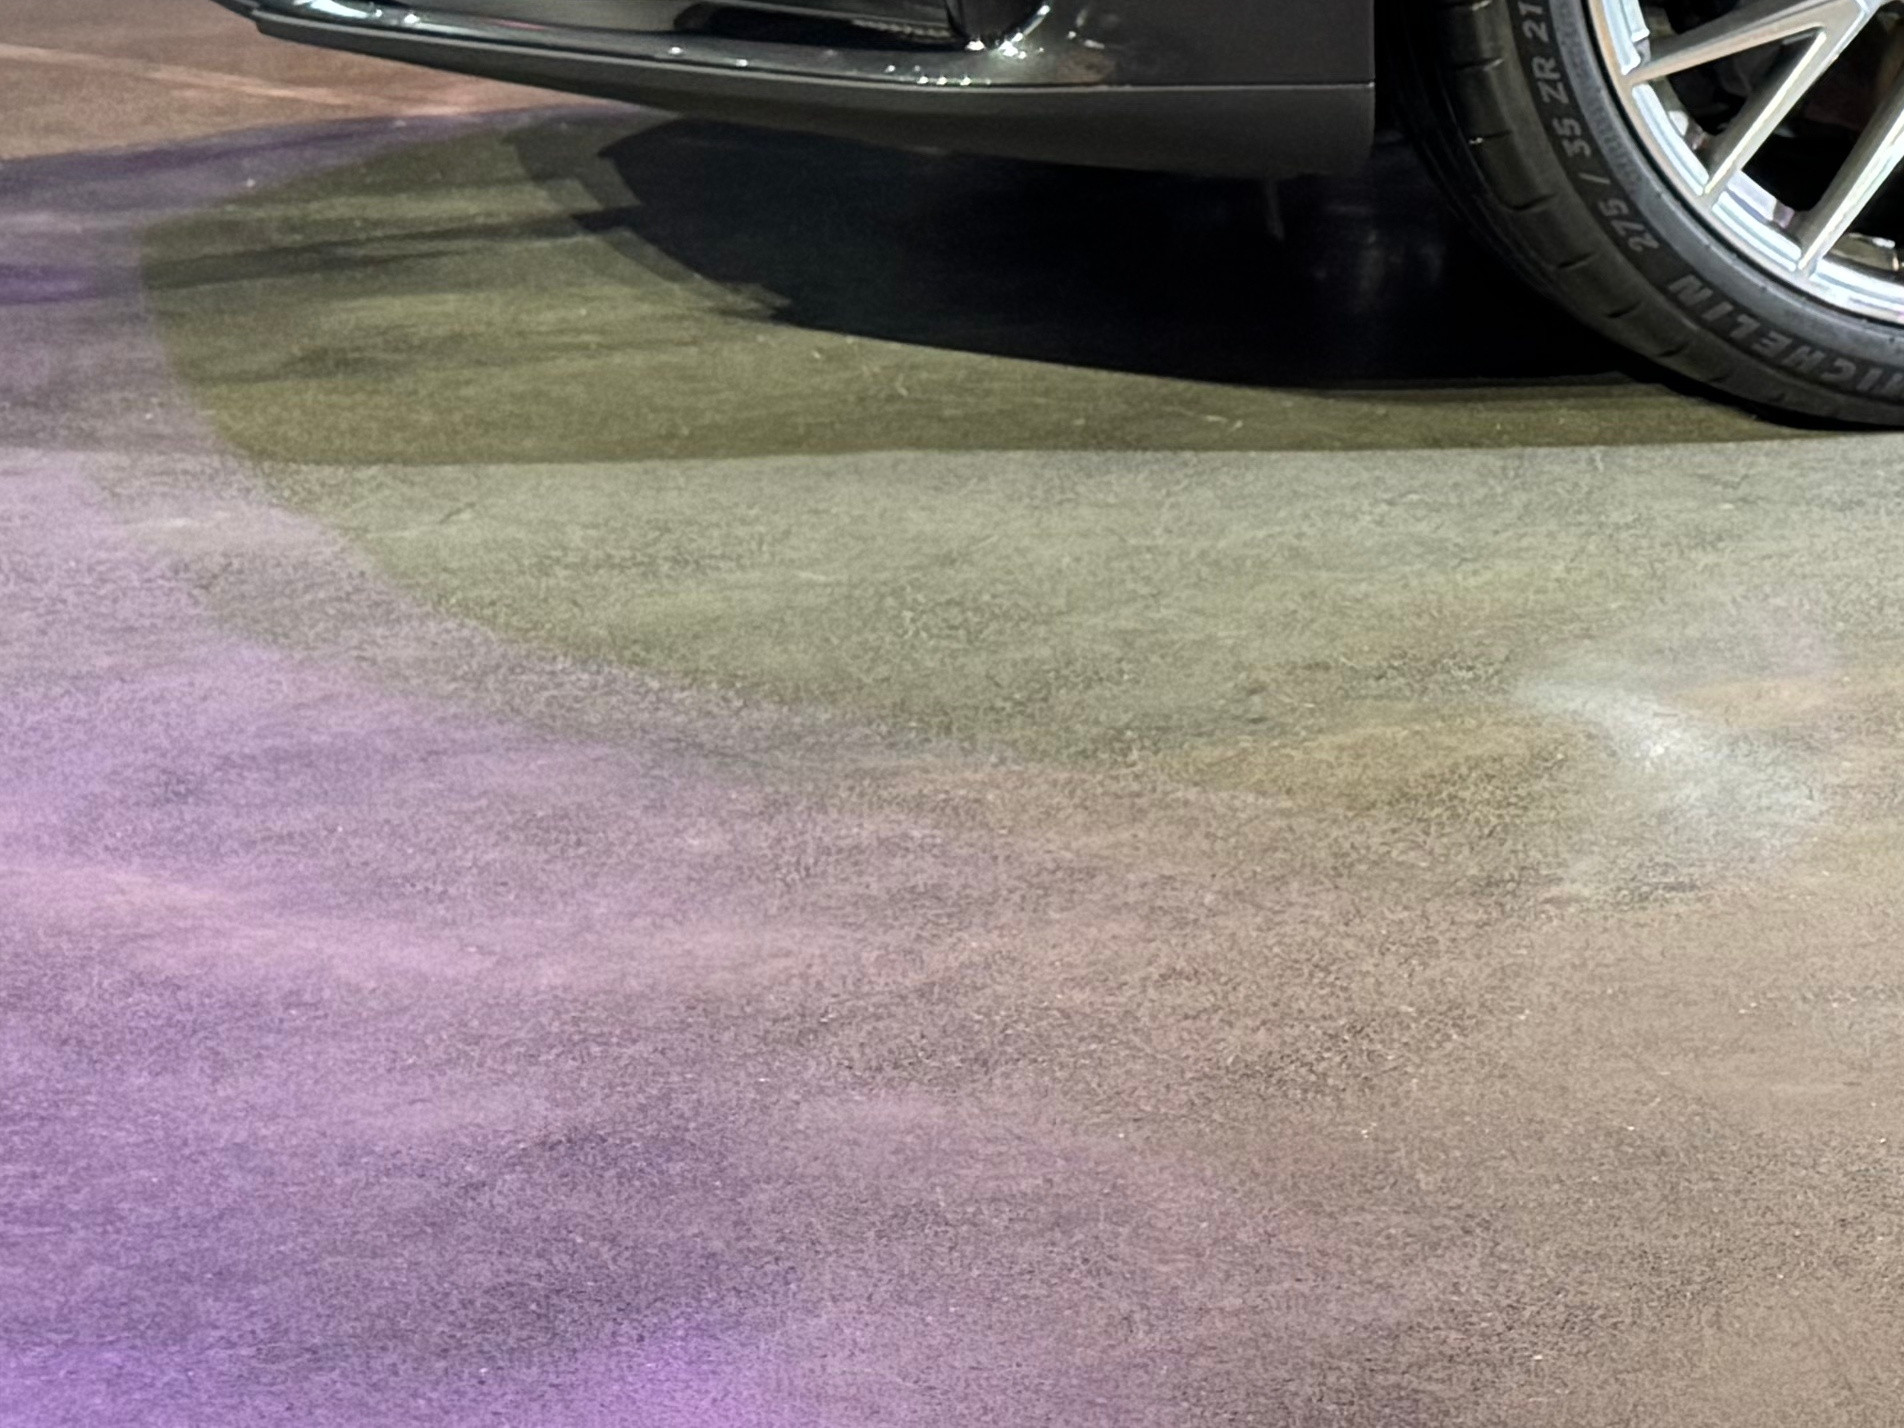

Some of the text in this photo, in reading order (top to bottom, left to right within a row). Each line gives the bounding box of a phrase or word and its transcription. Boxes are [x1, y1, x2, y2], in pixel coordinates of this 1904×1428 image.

[1517, 1, 1549, 41] 21
[1530, 55, 1568, 104] ZR
[1553, 120, 1593, 160] 35
[1598, 197, 1661, 254] 275
